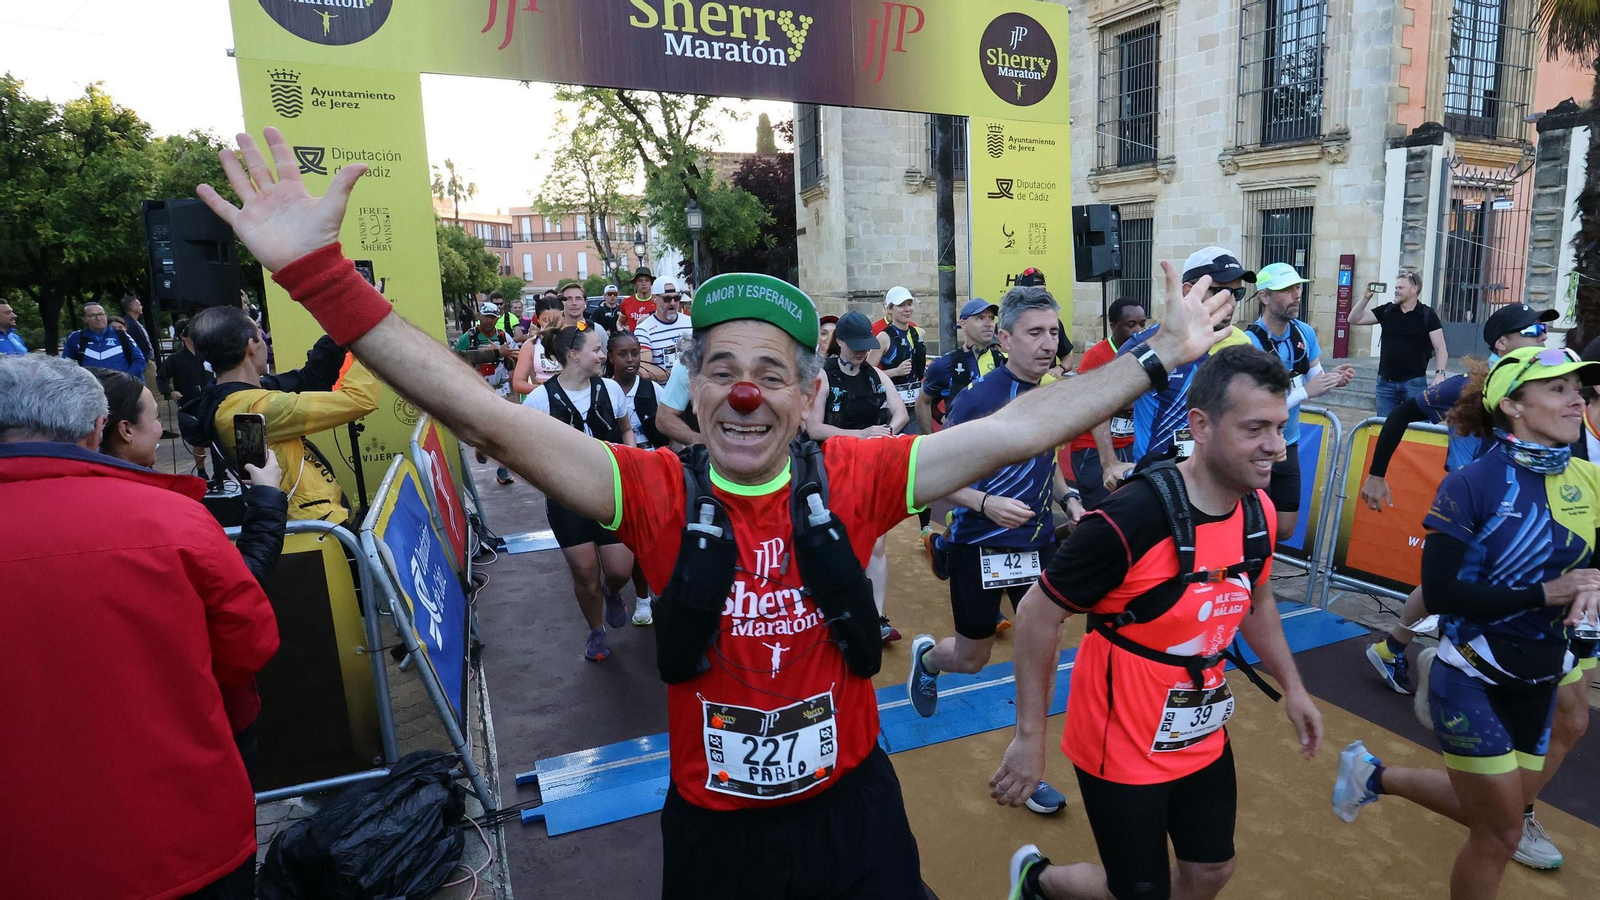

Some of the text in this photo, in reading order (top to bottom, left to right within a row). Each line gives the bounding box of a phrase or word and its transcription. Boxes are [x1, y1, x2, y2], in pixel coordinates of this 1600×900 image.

[629, 0, 813, 63] Sherry
[663, 32, 787, 66] Maratón
[986, 47, 1051, 78] Sherry
[998, 66, 1041, 80] Maratón
[310, 86, 396, 101] Ayuntamiento
[312, 98, 360, 109] de Jerez
[1008, 135, 1056, 146] Ayuntamiento
[1018, 144, 1035, 152] Jerez
[331, 147, 402, 162] Diputación
[1016, 179, 1056, 190] Diputación
[1017, 191, 1049, 202] de Cádiz
[359, 207, 389, 216] JEREZ
[361, 243, 392, 251] SHERRY
[704, 284, 803, 323] AMOR Y ESPERANZA
[906, 390, 915, 399] 52
[1123, 419, 1135, 429] 17
[1003, 553, 1022, 570] 42
[731, 614, 819, 637] Maratón
[1190, 705, 1213, 727] 39
[742, 732, 799, 767] 227
[748, 760, 807, 782] PABLO
